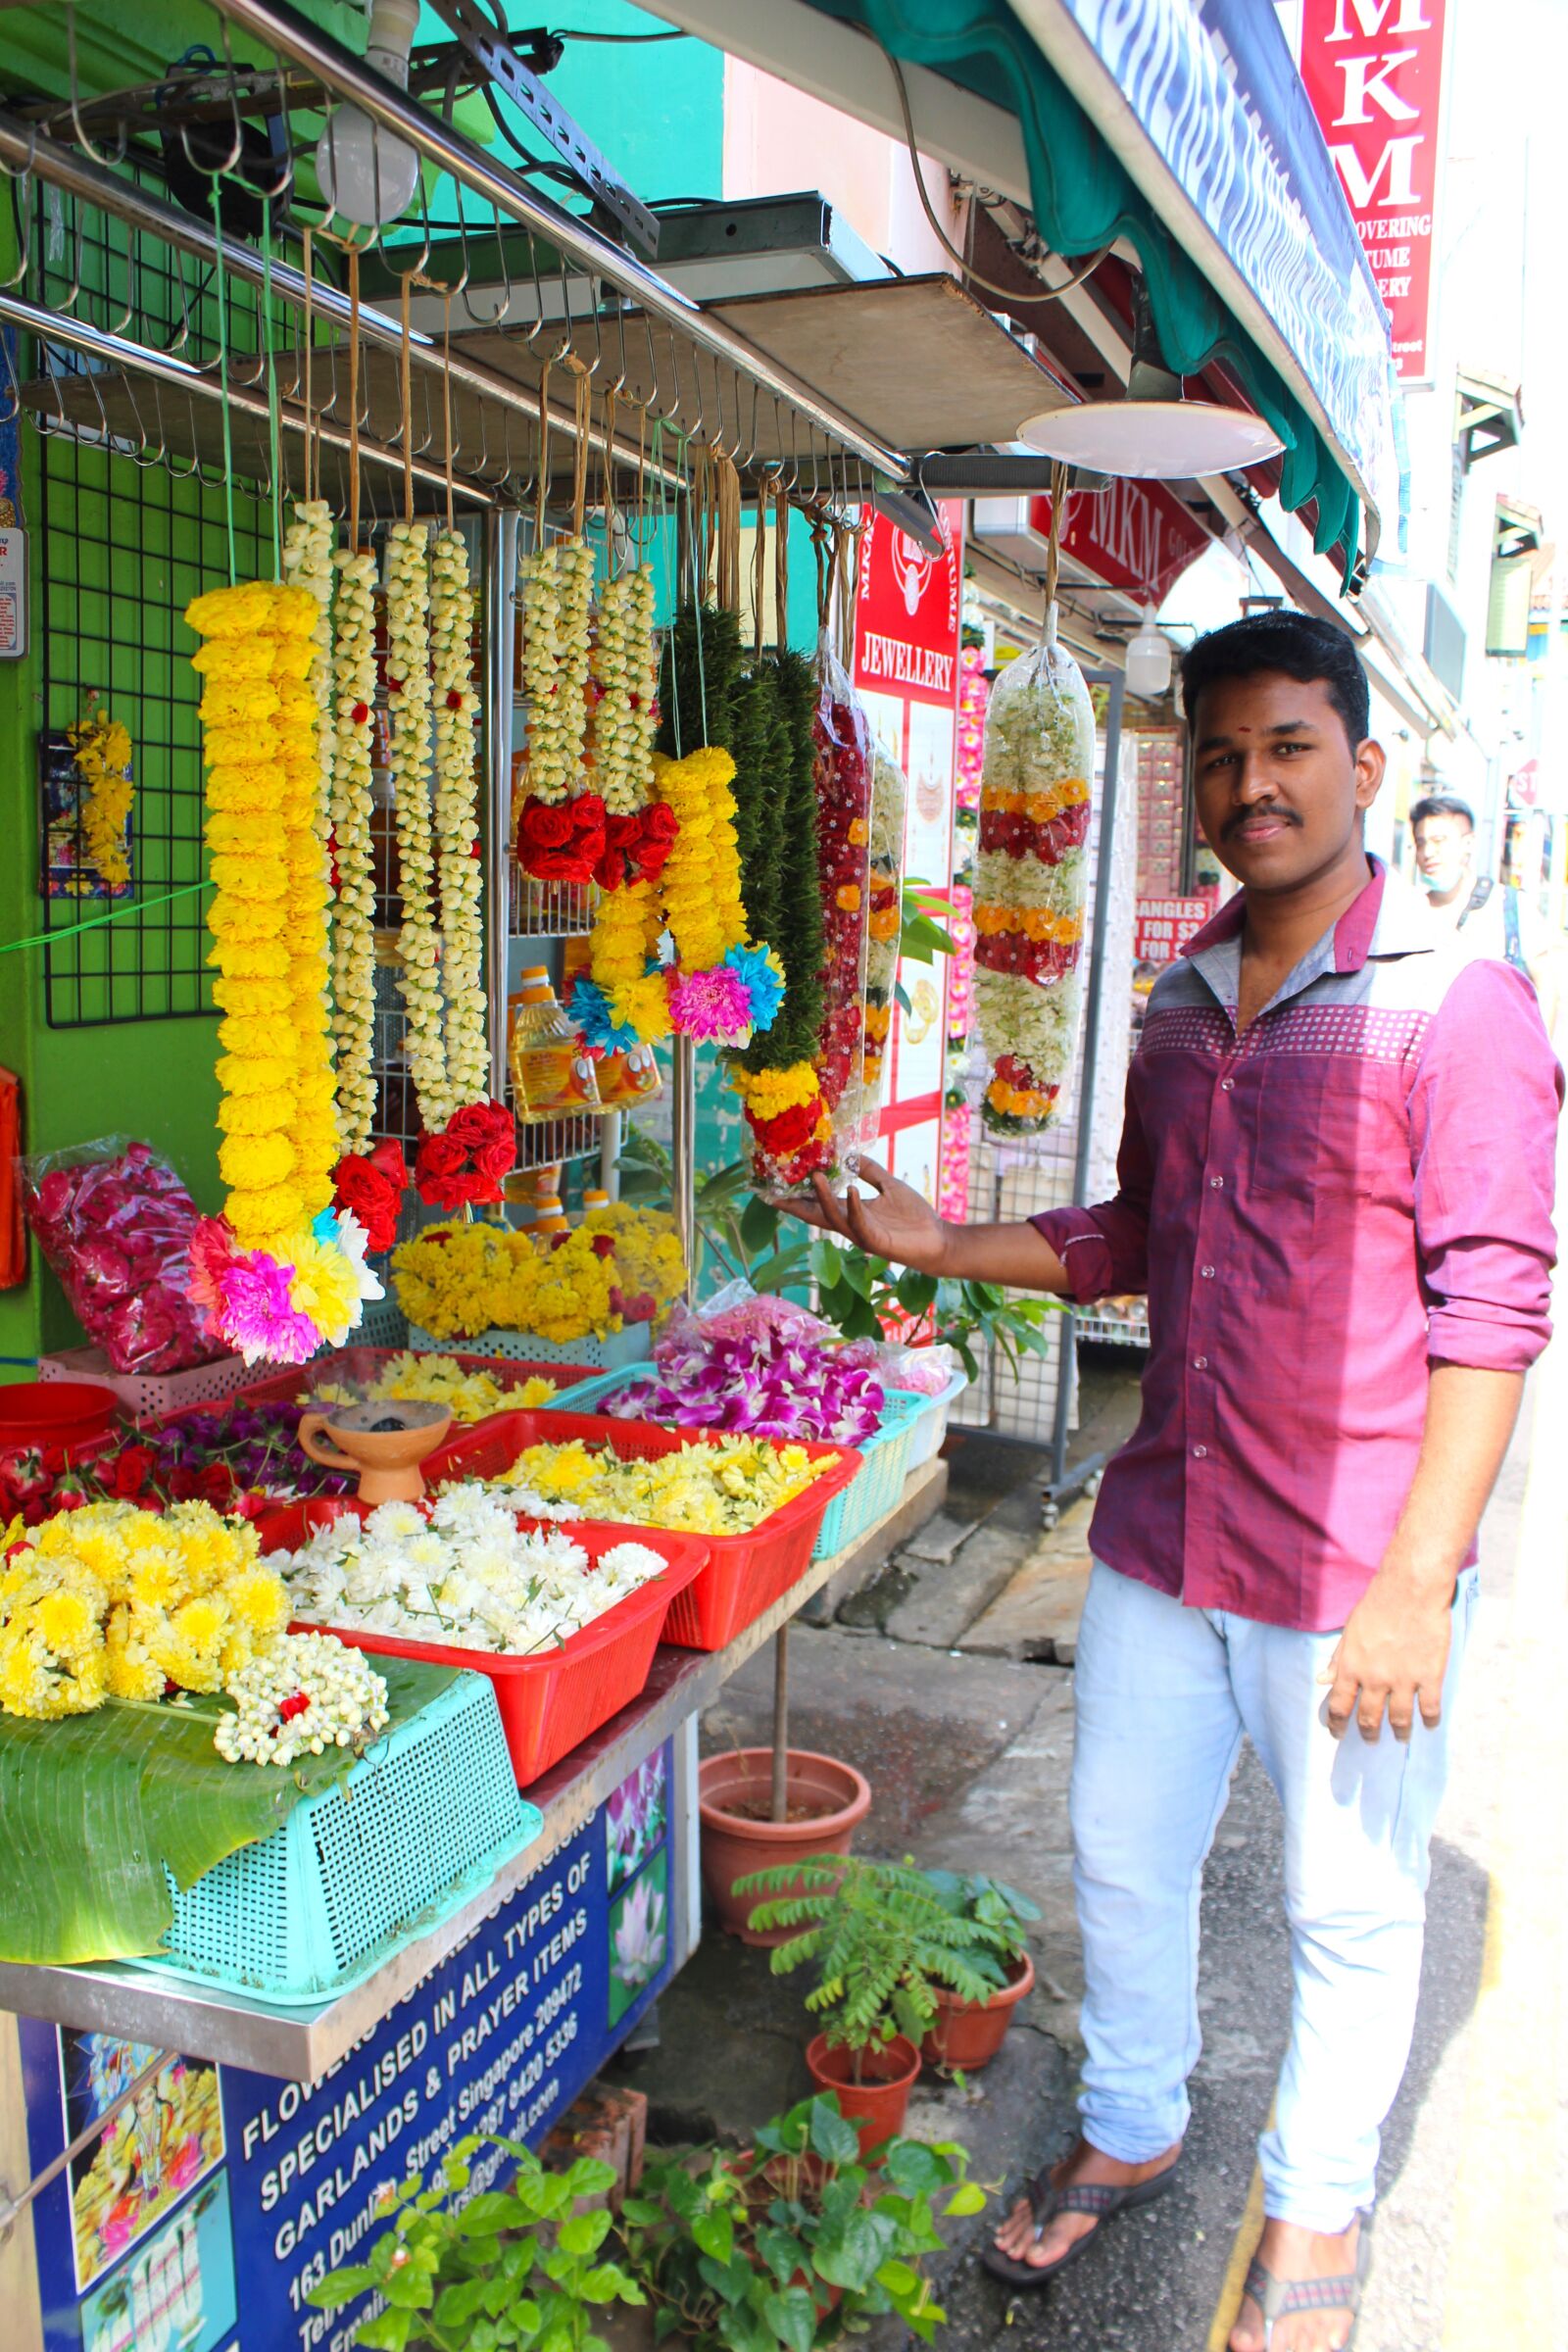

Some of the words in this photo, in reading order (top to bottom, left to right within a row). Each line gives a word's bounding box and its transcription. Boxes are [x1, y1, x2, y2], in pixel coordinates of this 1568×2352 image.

[1089, 477, 1163, 593] MKM
[861, 631, 954, 692] JEWELLERY
[1139, 900, 1205, 920] ANGLES
[1140, 940, 1169, 959] FOR
[1144, 919, 1173, 940] FOR
[262, 2020, 427, 2212] SPECIALISED
[433, 1988, 456, 2035] IN
[461, 1950, 501, 2008] ALL
[504, 1881, 564, 1959] TYPES
[567, 1851, 591, 1895] OF
[274, 2088, 418, 2261] GARLANDS
[425, 2066, 442, 2100] &
[448, 1970, 530, 2077] PRAYER
[533, 1908, 587, 1984] ITEMS
[289, 2251, 325, 2312] 163
[406, 2105, 457, 2181] Street
[459, 2023, 534, 2122] Singapore
[535, 1962, 583, 2035] 209472
